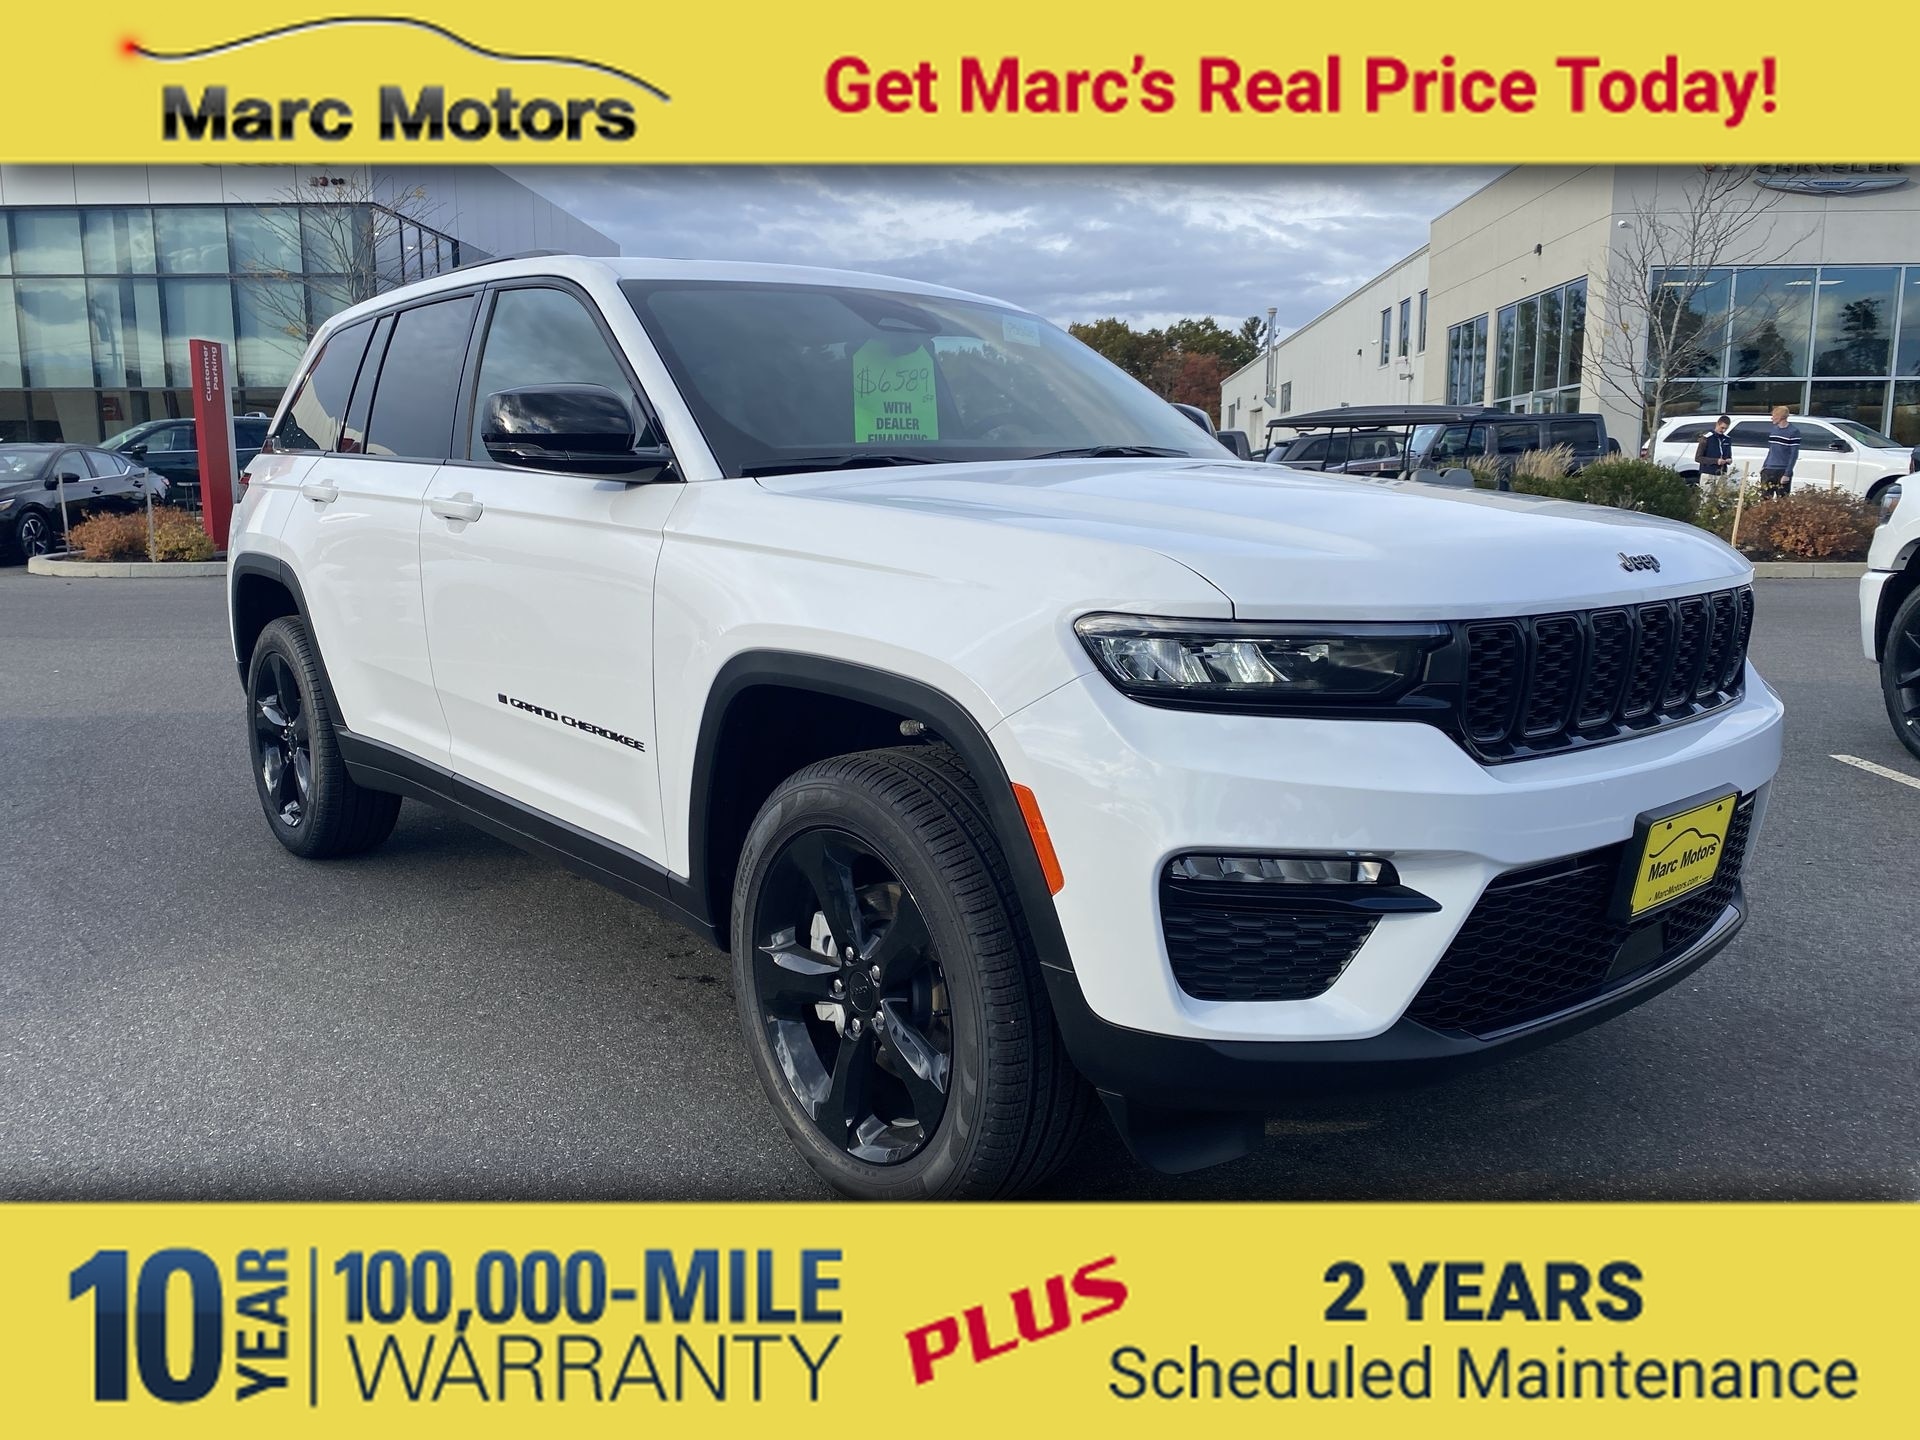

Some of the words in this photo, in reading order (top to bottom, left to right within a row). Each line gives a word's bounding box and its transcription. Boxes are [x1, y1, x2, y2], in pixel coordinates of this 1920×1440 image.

[203, 345, 211, 401] Customer
[211, 346, 219, 391] Parking
[876, 417, 919, 430] DEALER
[883, 402, 912, 414] WITH
[1617, 552, 1661, 573] Jeep
[510, 698, 558, 721] GRAND
[561, 715, 645, 752] CHEROKEE
[1648, 859, 1678, 882] Marc
[1680, 842, 1717, 869] Motors
